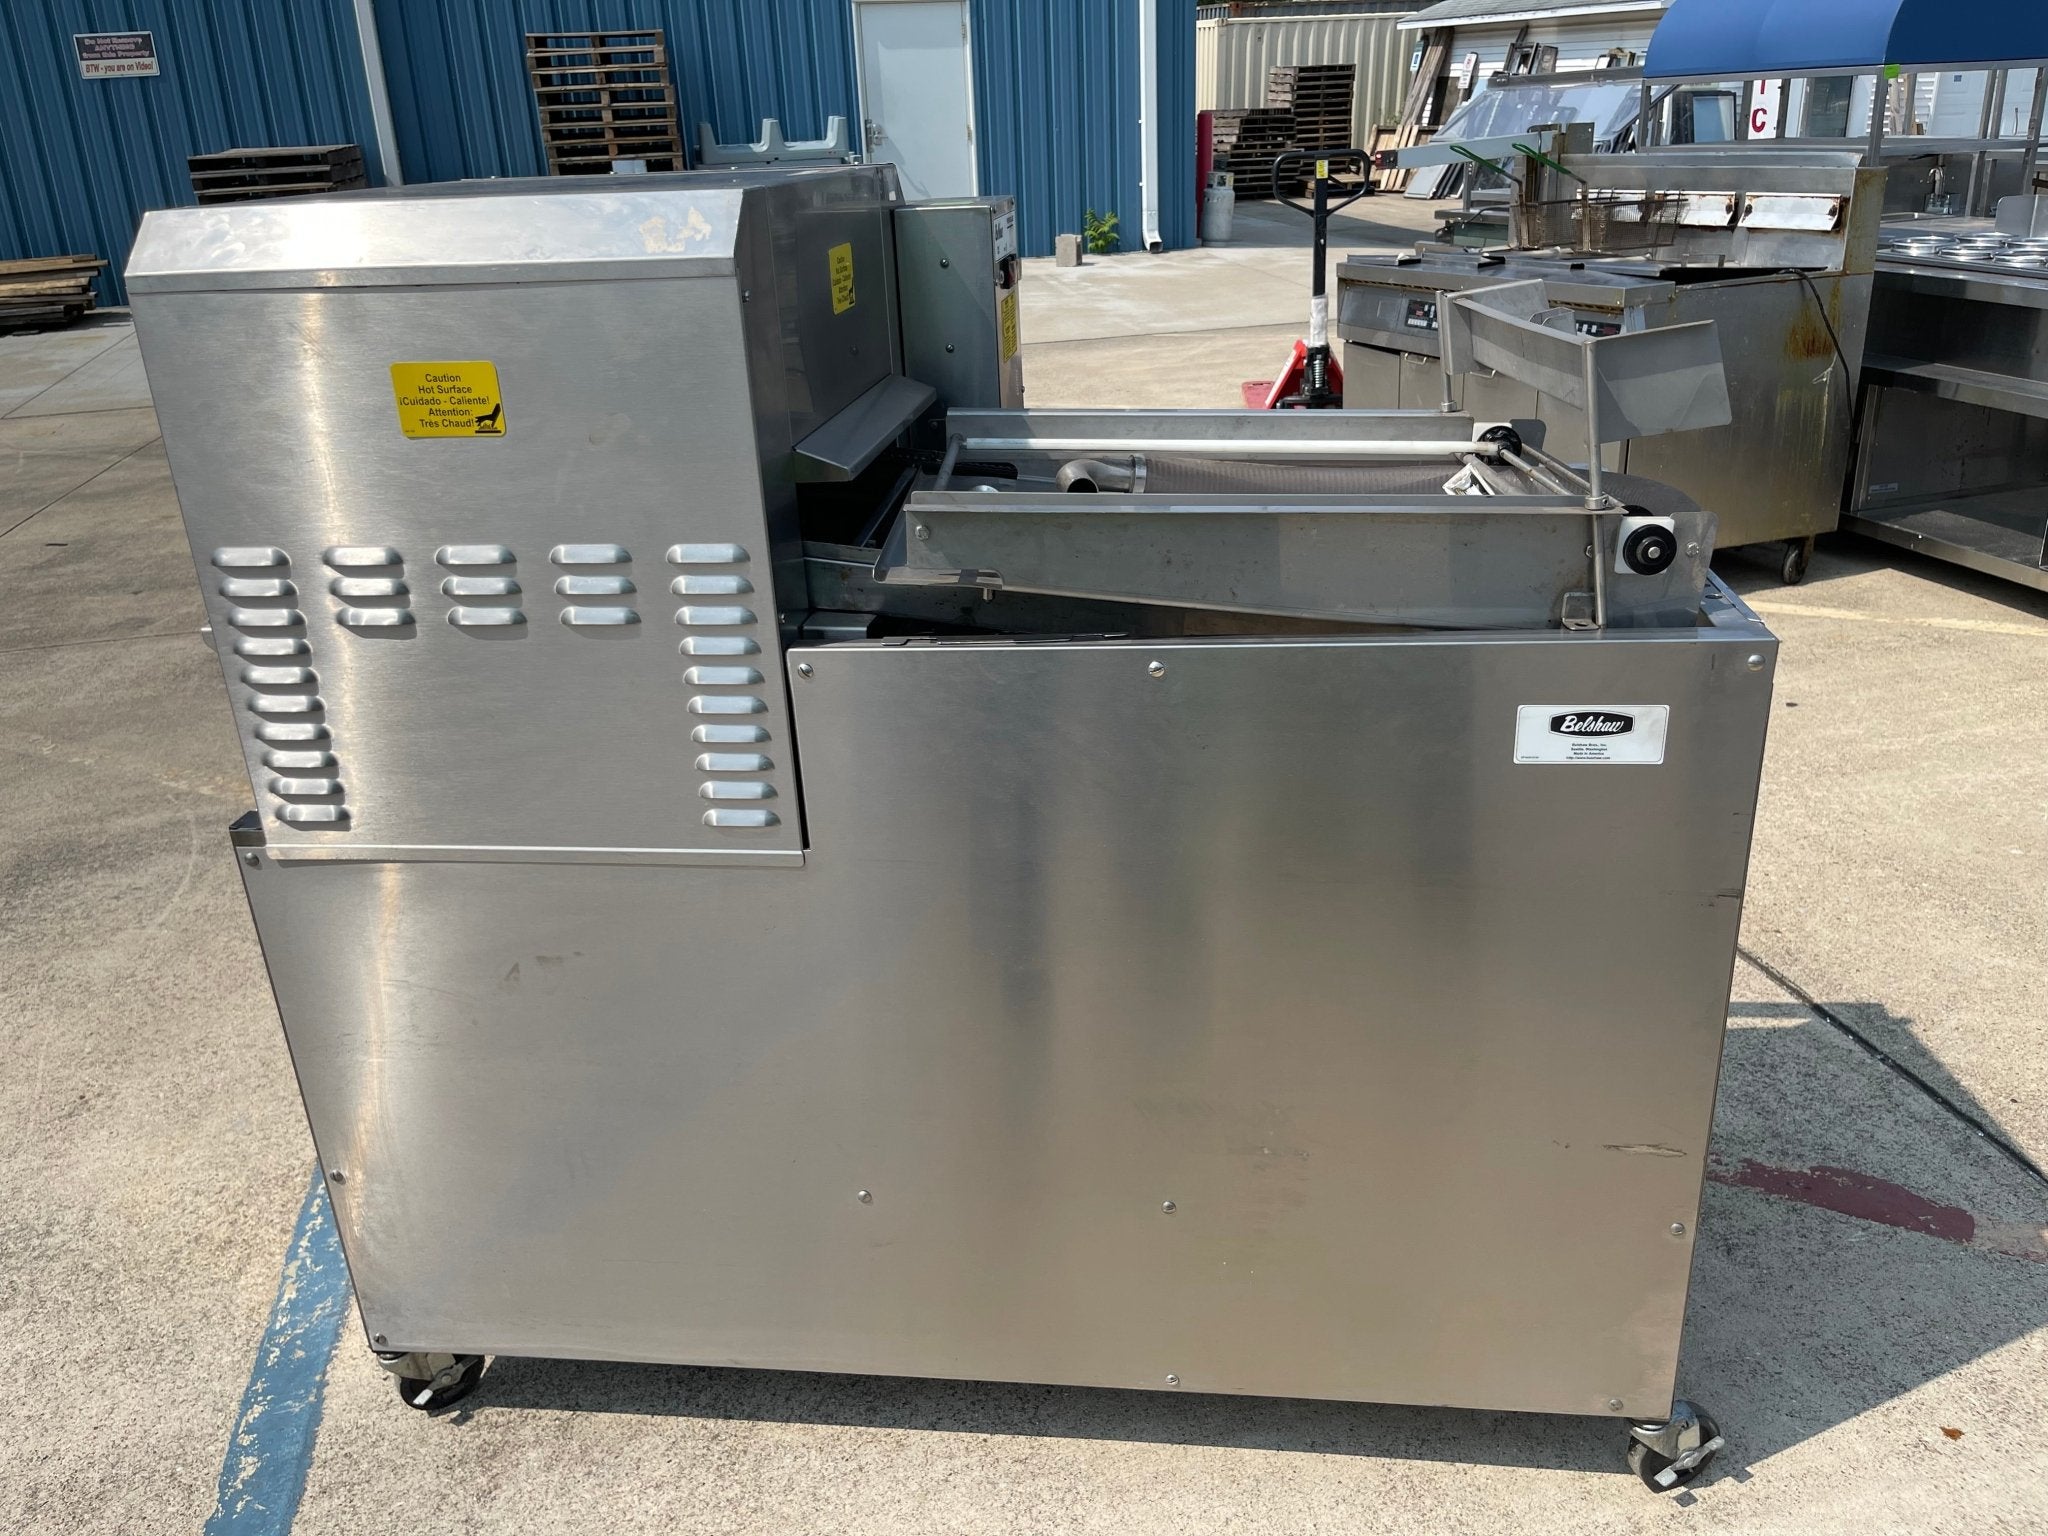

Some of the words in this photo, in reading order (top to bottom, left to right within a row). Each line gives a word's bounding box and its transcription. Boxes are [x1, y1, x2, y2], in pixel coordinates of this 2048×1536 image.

[86, 64, 99, 73] BTW
[104, 64, 116, 74] you
[116, 64, 126, 72] are
[135, 61, 153, 70] Video!
[425, 373, 462, 383] Caution
[418, 385, 435, 394] Hot
[437, 384, 472, 394] Surface
[449, 395, 490, 405] Caliente!
[428, 407, 474, 417] Attention:
[441, 418, 475, 428] Chaud!
[1560, 715, 1625, 733] Belshaw
